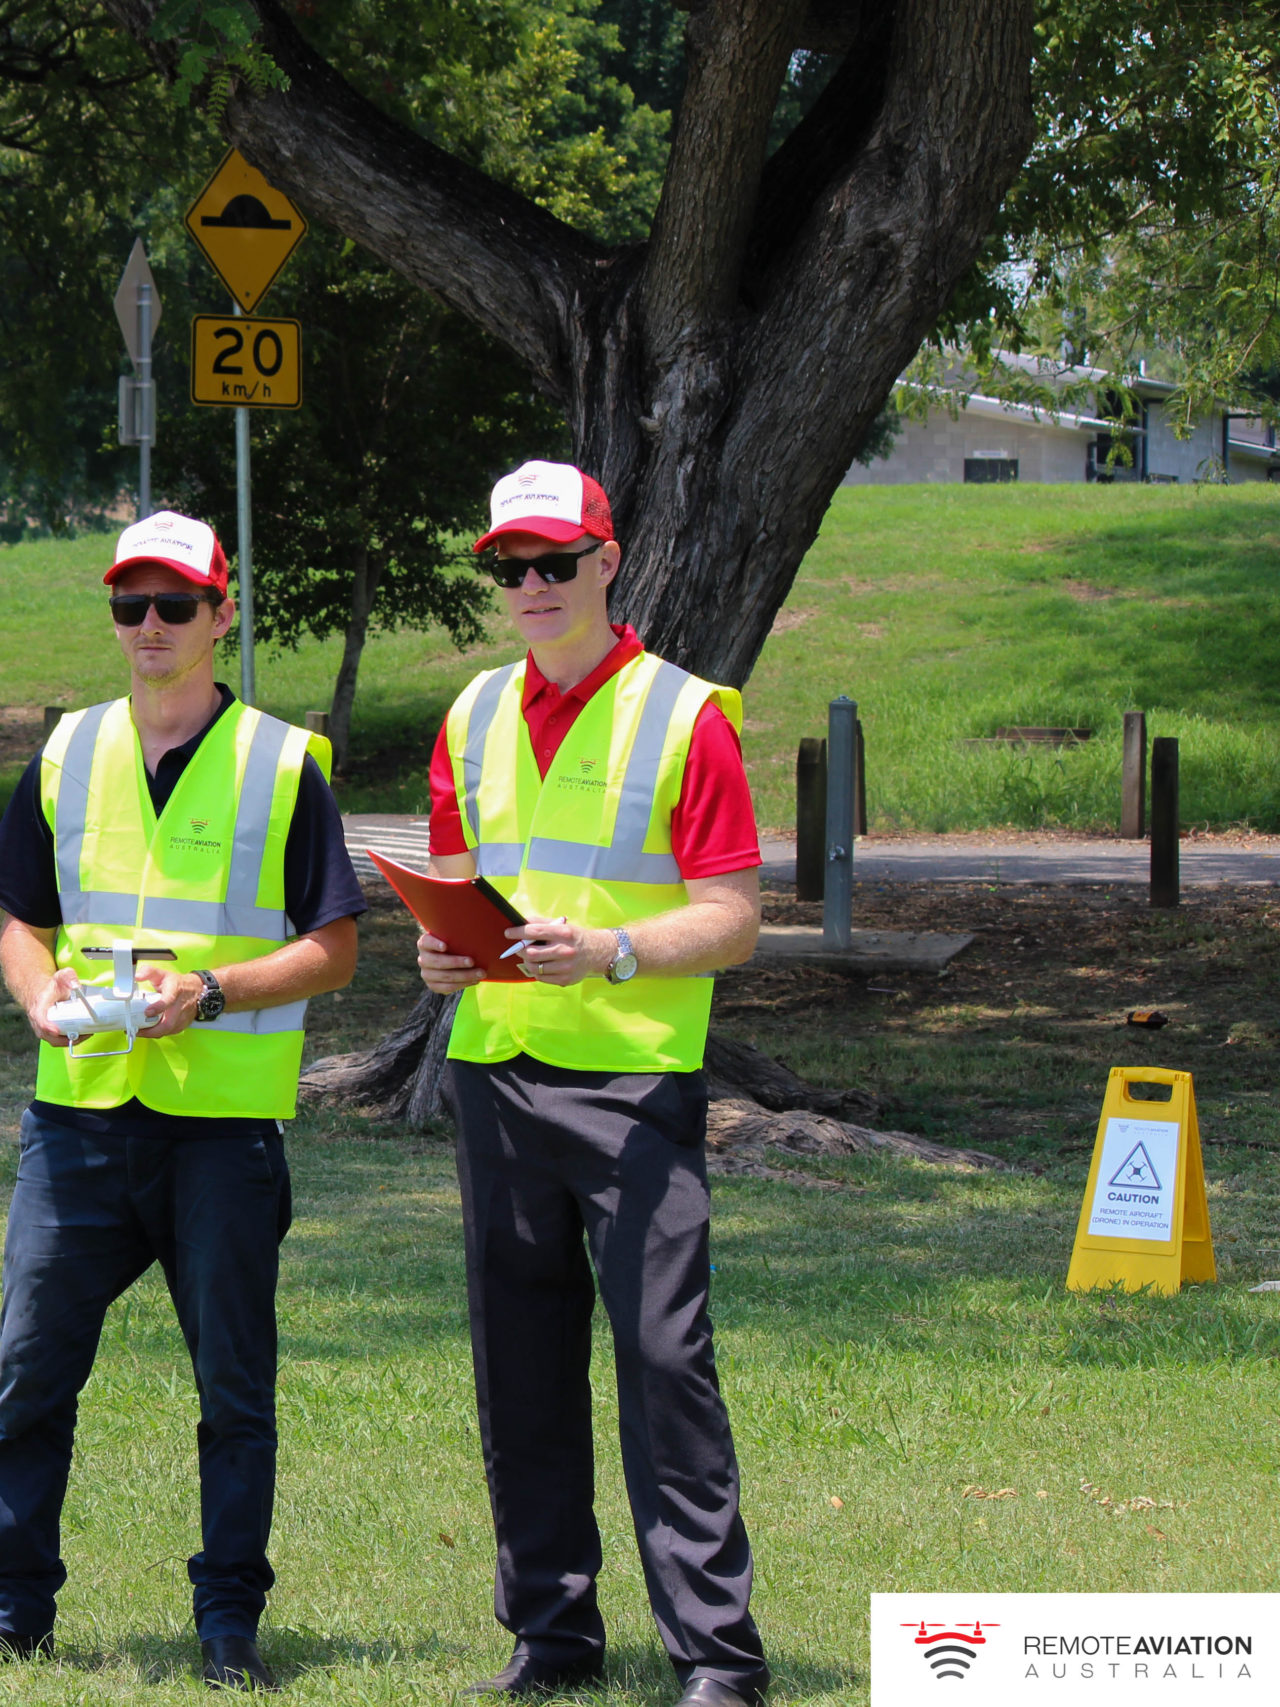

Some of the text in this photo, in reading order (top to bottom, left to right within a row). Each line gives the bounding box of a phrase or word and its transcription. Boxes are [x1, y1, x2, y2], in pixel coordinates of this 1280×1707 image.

[212, 327, 283, 377] 20
[222, 381, 271, 400] km/h
[1107, 1192, 1160, 1205] CAUTION
[1100, 1208, 1163, 1218] REMOTE AIRCRAFT
[1092, 1217, 1121, 1225] (DRONE)
[1130, 1220, 1169, 1229] OPERATION
